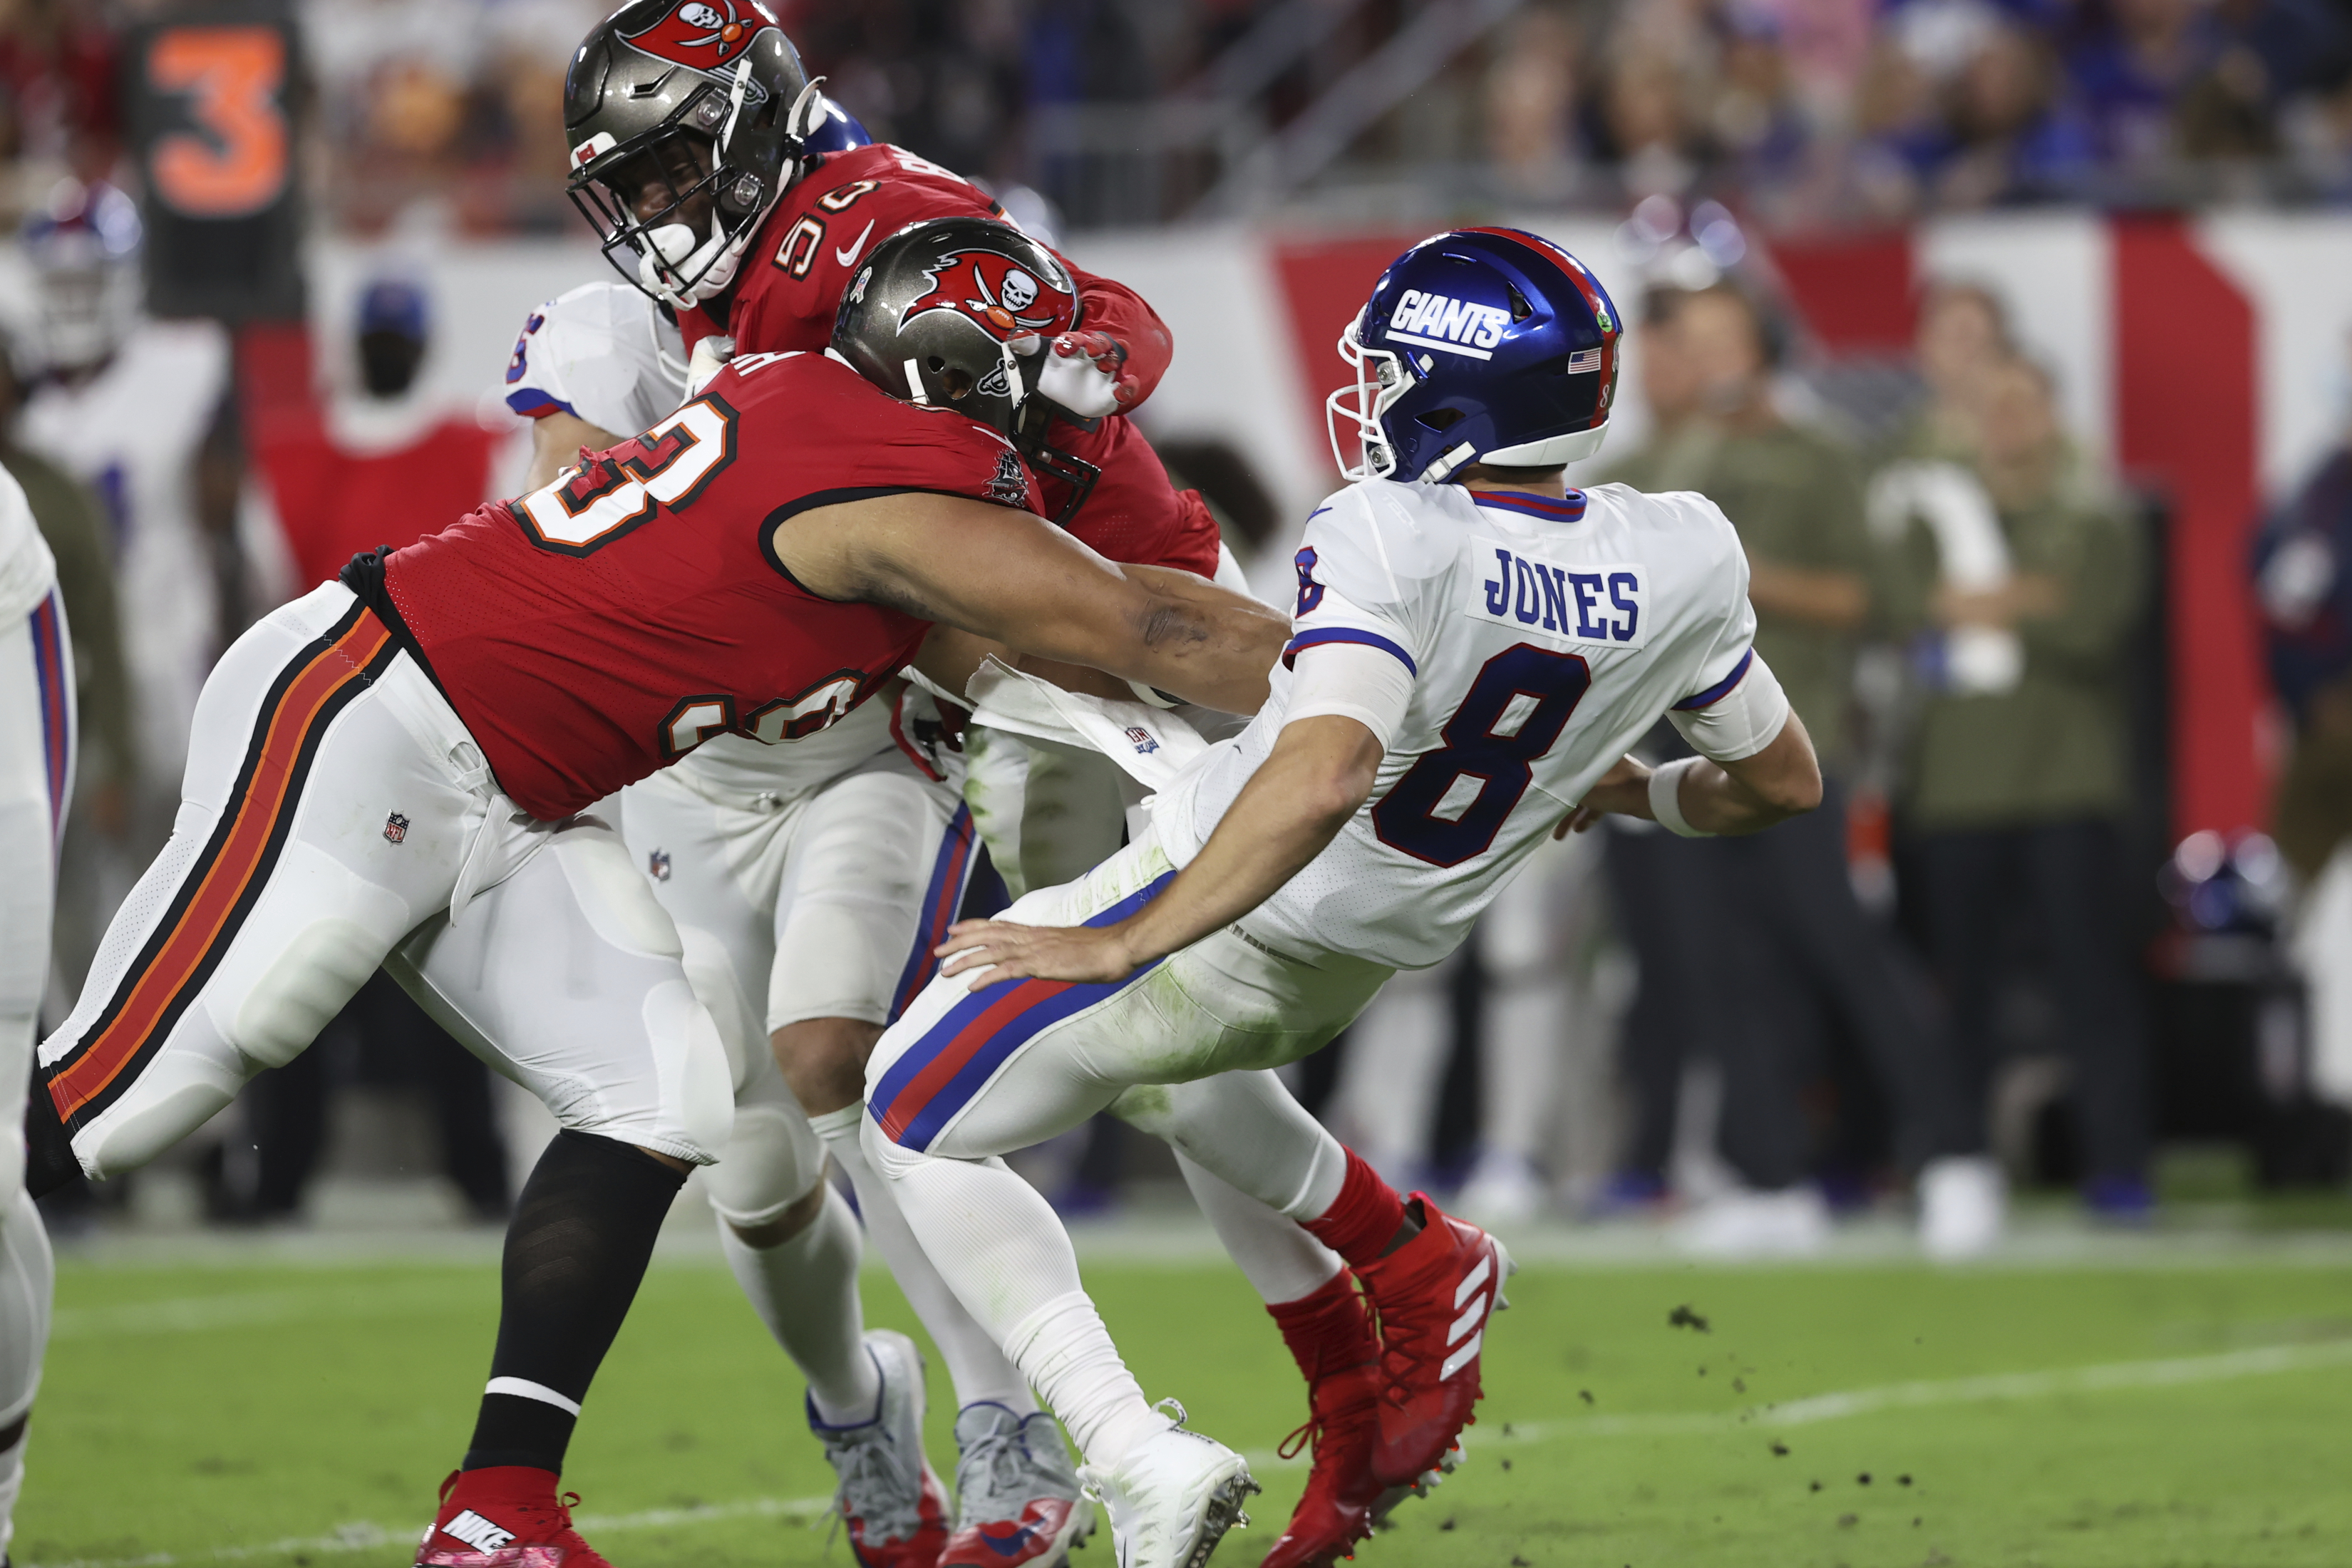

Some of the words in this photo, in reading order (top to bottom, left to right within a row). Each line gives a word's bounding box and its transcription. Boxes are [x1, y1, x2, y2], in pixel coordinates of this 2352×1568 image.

[146, 24, 287, 216] 3
[1390, 289, 1511, 349] GIANTS
[1599, 384, 1610, 408] 8
[1485, 548, 1639, 641] JONES
[1371, 642, 1592, 868] 8
[386, 822, 403, 840] NFL
[440, 1508, 517, 1557] NIKE
